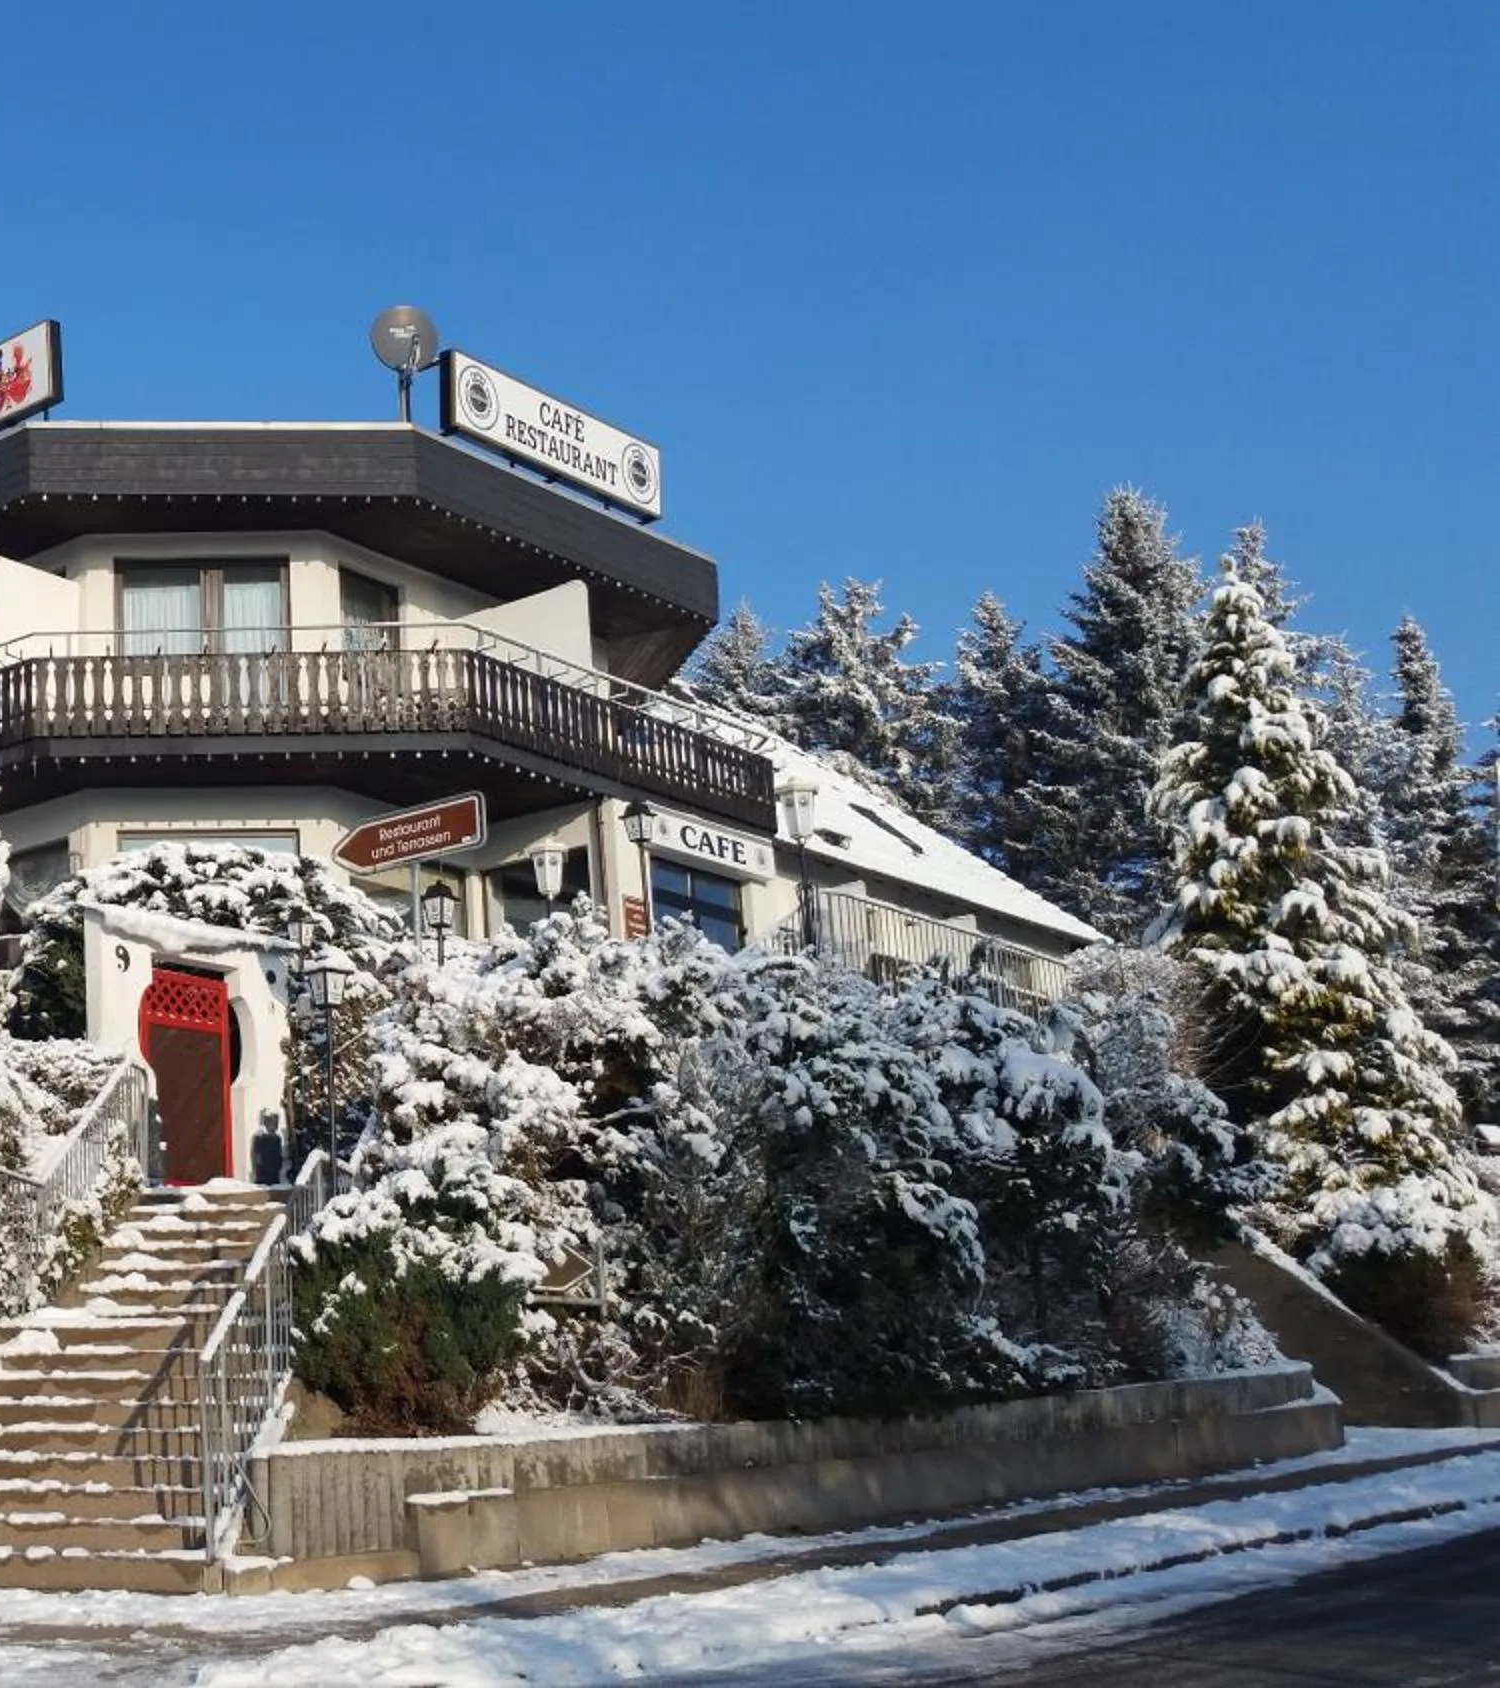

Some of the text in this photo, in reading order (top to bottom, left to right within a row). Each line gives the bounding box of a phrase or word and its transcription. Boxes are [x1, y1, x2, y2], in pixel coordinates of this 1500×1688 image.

[539, 401, 585, 444] CAFÉ
[505, 413, 618, 487] RESTAURANT
[379, 815, 441, 841] Restaurant
[680, 825, 747, 865] CAFE
[371, 842, 395, 860] und
